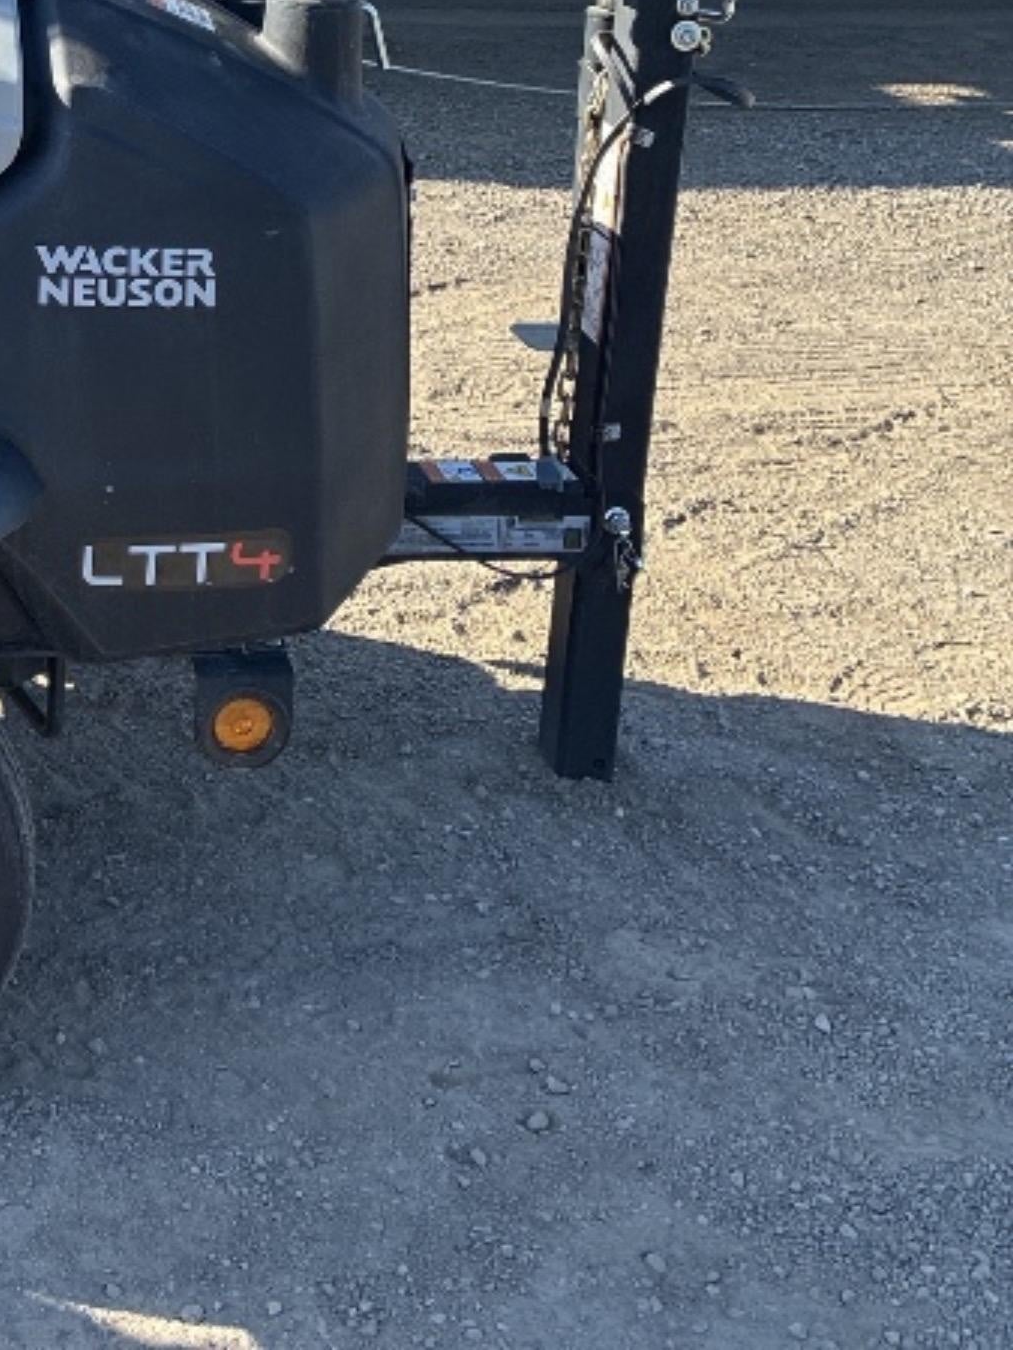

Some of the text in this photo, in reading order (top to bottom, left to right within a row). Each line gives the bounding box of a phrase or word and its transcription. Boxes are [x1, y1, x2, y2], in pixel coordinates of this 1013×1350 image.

[35, 245, 216, 277] WACKER
[38, 277, 216, 307] NEUSON
[82, 541, 282, 586] LTT4
